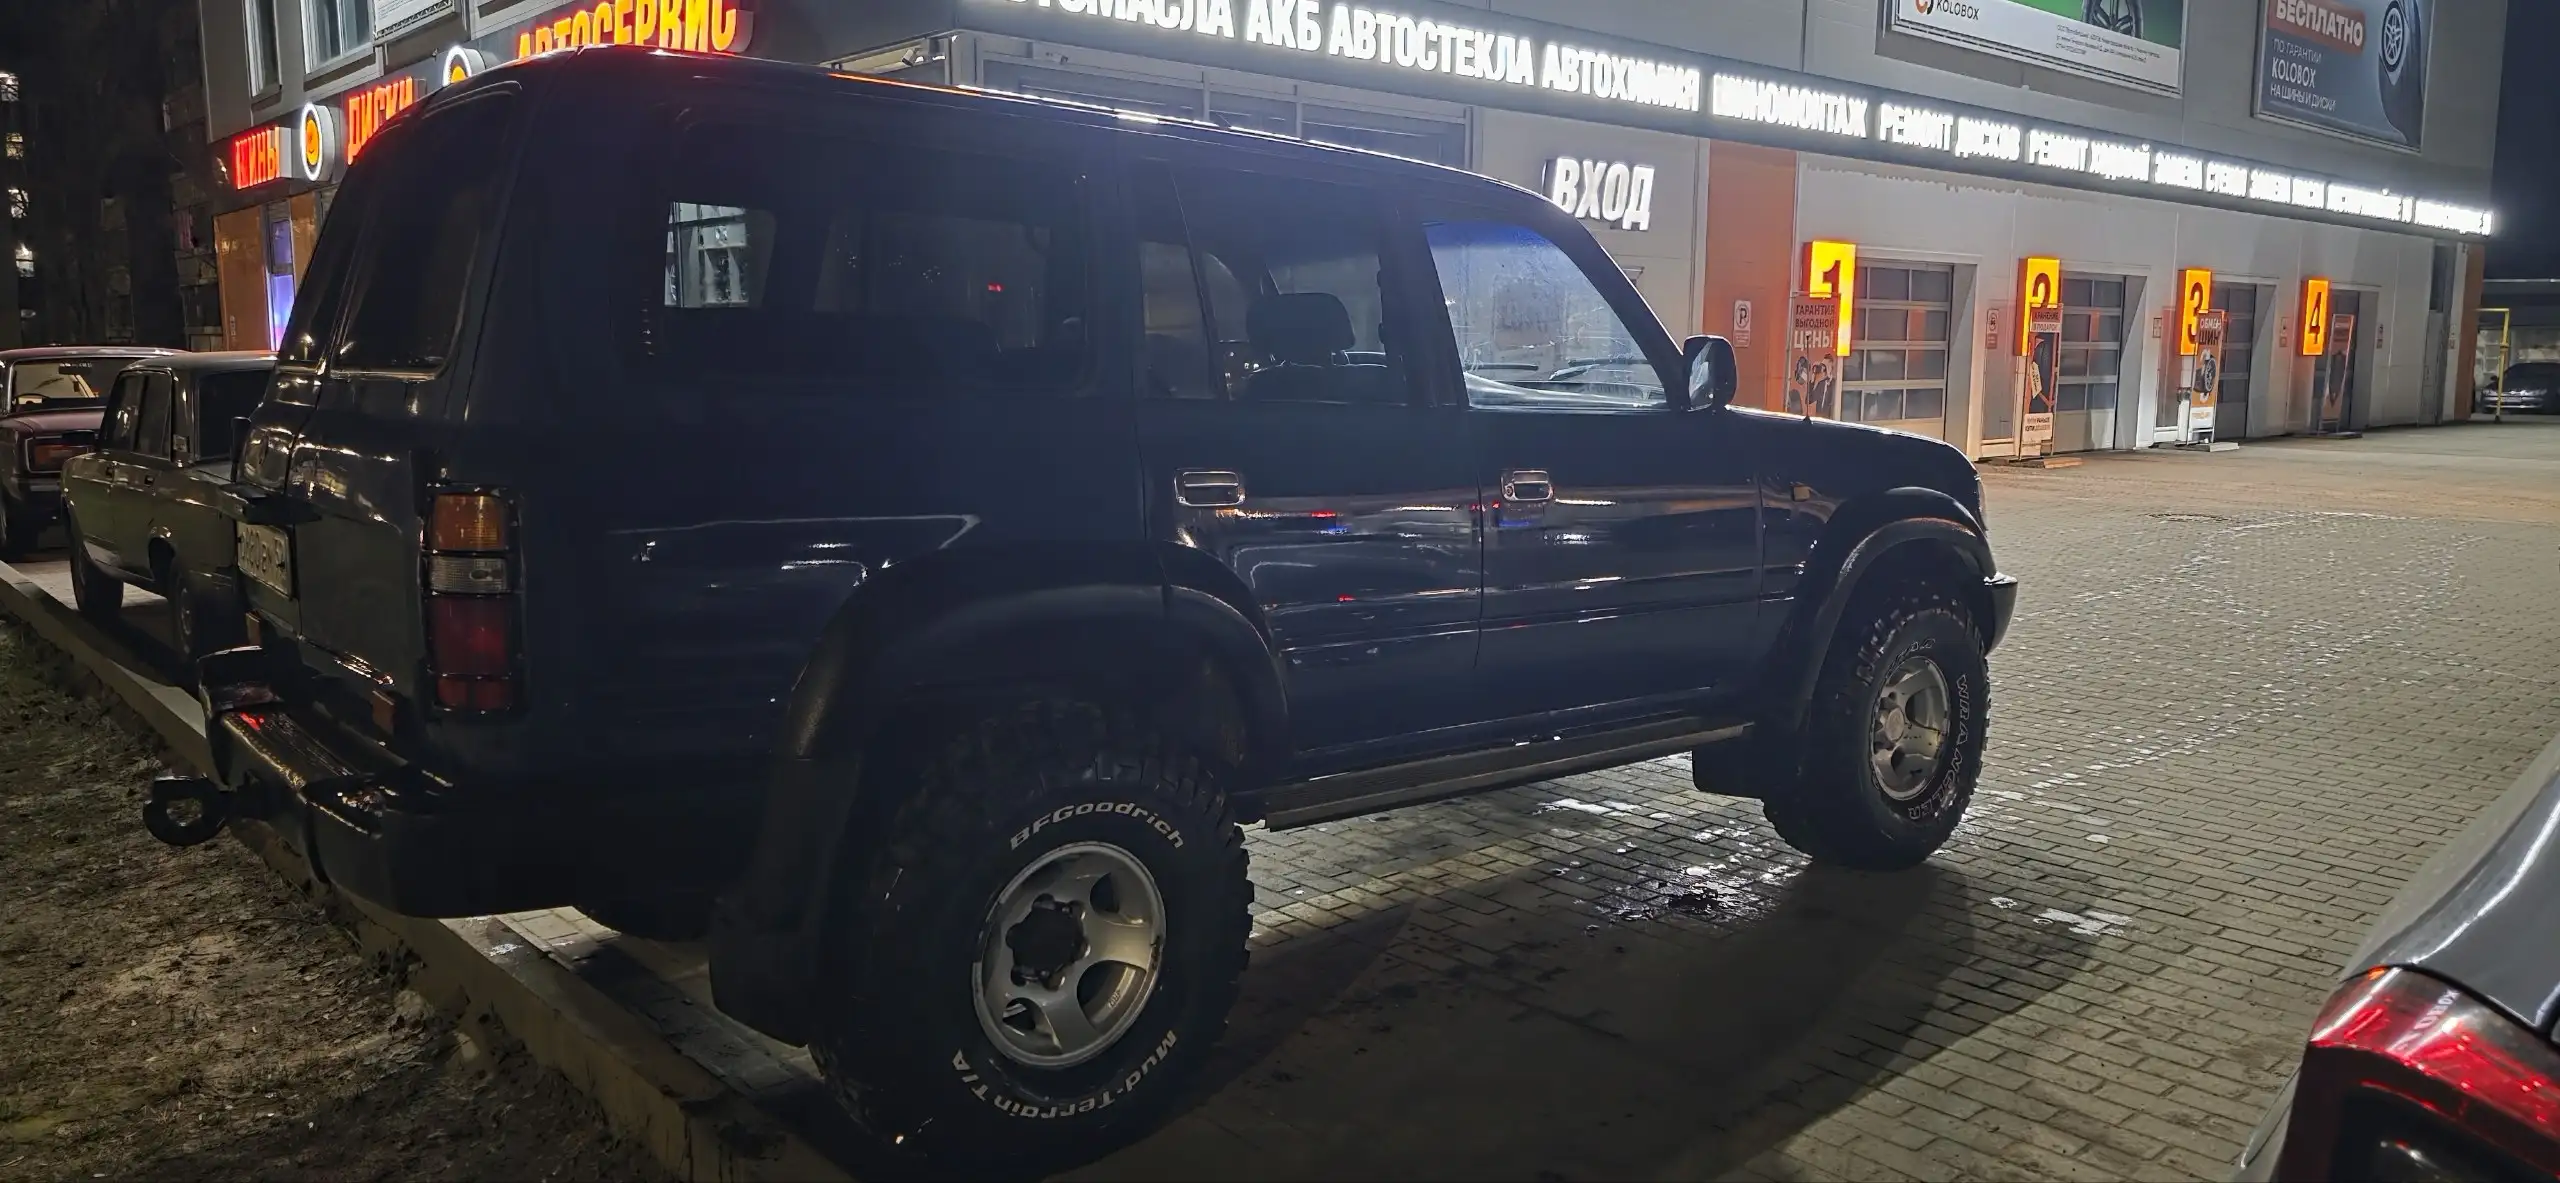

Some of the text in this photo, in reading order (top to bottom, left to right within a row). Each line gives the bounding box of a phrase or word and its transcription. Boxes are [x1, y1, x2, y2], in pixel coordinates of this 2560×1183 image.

[1936, 0, 1980, 20] KOLOBOX
[2275, 0, 2364, 47] БЕСПЛАТНО
[1246, 0, 1322, 51] АКБ
[1328, 5, 1535, 86] АВТОСТЕКЛА
[1541, 42, 1700, 112] АВТОХИМИЯ
[2271, 56, 2316, 88] KOLOBOX
[2273, 38, 2322, 64] ПО ГАРАНТИИ
[2270, 83, 2281, 98] НА
[2281, 85, 2305, 103] ШИНЫ
[2311, 93, 2336, 112] ДИСКИ
[235, 126, 281, 190] ШИНЫ
[1552, 156, 1656, 232] ВХОД
[1796, 304, 1835, 316] ГАРАНТИЯ
[2187, 282, 2204, 345] 3
[2200, 317, 2222, 330] ОБМЕН
[2308, 291, 2322, 345] 4
[1794, 330, 1834, 351] ЦЕНЫ
[1010, 801, 1184, 851] BFGoodrich
[993, 1029, 1178, 1119] Mud-Terrain
